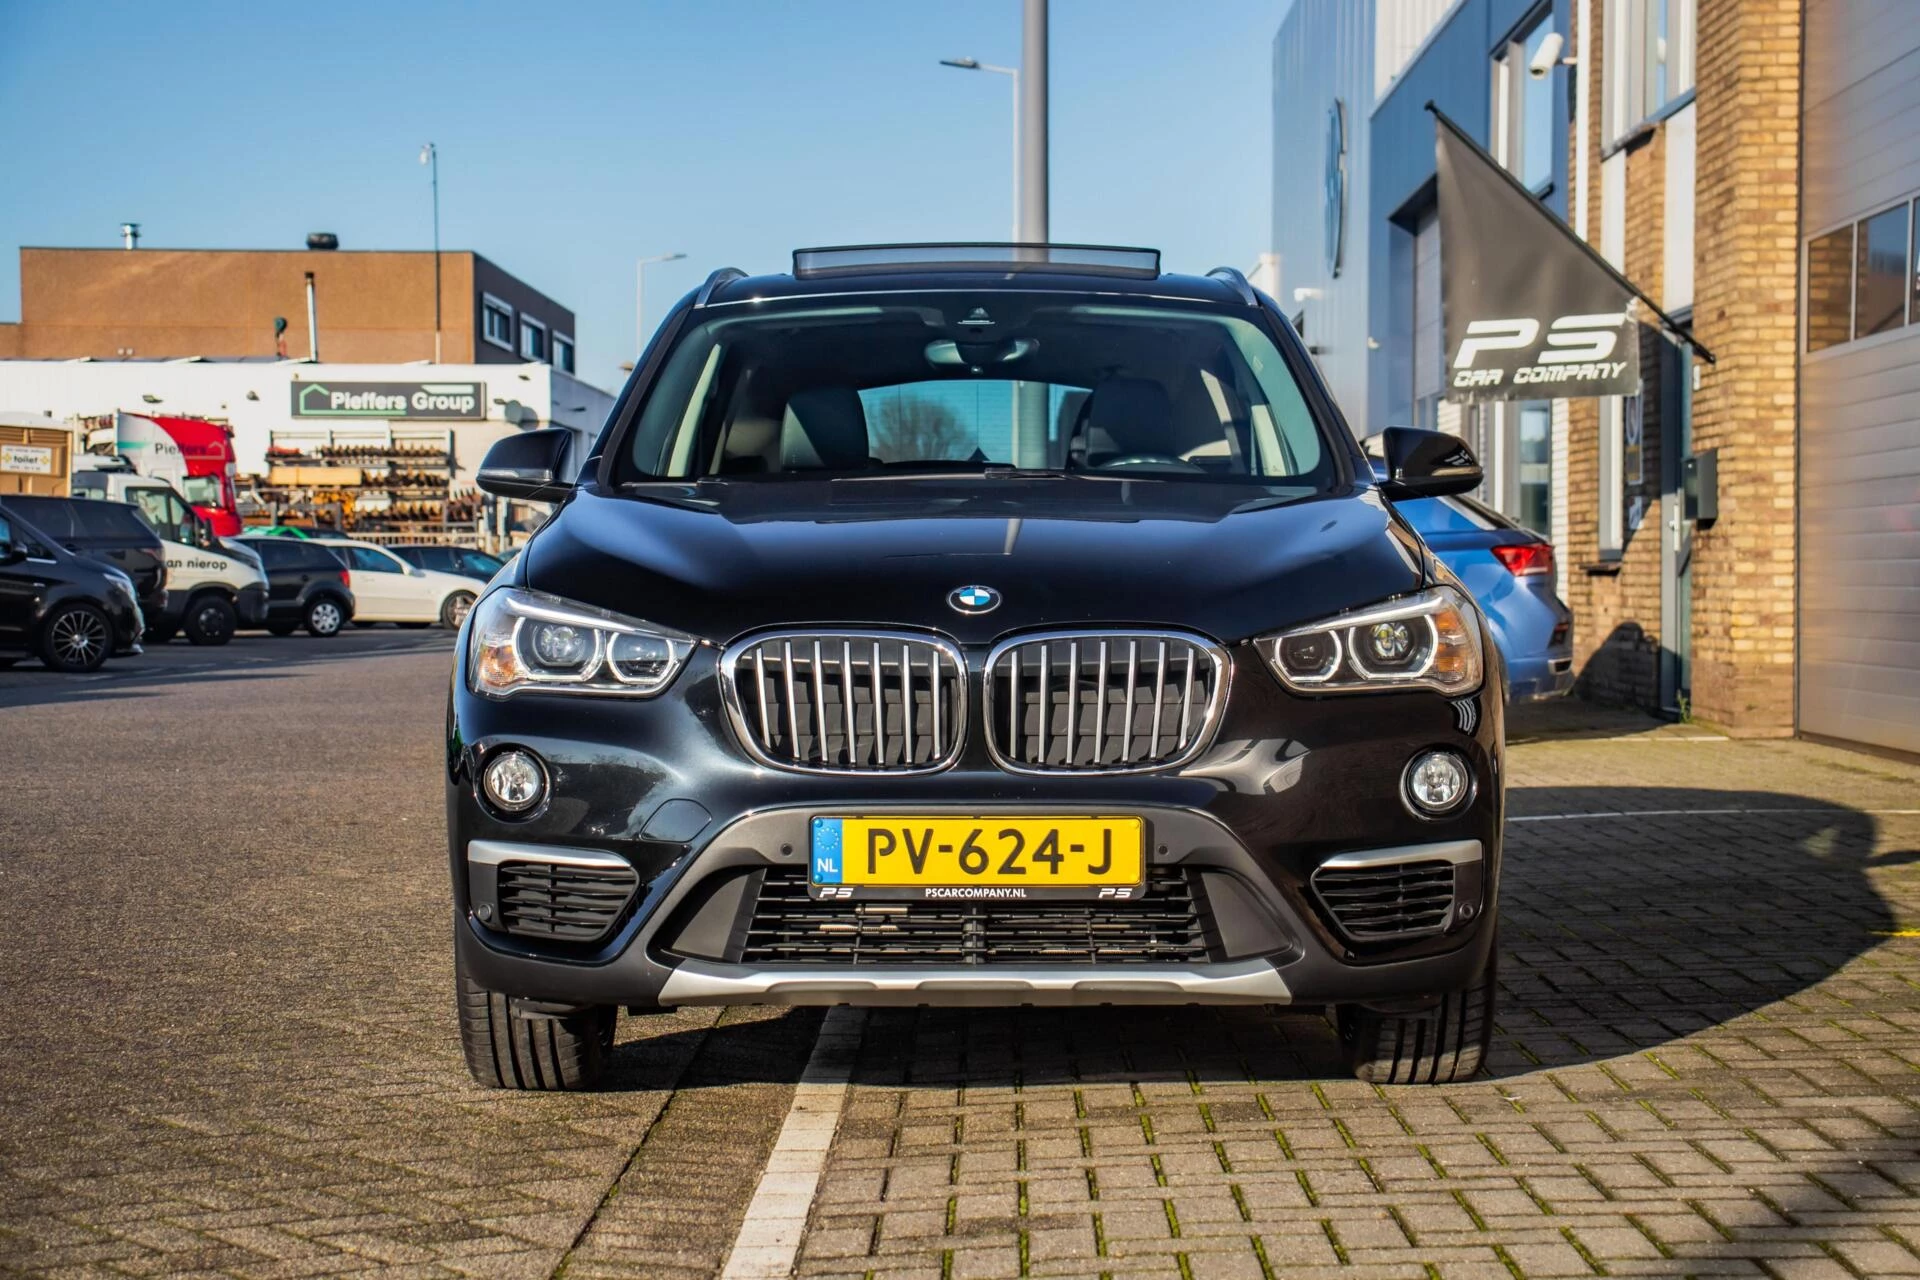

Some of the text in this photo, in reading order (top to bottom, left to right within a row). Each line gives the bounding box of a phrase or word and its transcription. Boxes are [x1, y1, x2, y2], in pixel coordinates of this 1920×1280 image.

[1453, 313, 1626, 368] PS
[1453, 361, 1627, 387] CAR COMPANY
[330, 391, 475, 414] Pieffers Group
[13, 454, 38, 464] toilet
[187, 557, 228, 571] nierop
[867, 828, 1112, 875] PV-624-J
[817, 858, 839, 873] NL
[819, 887, 1133, 898] PS PSCARCOMPANY.NL PS
